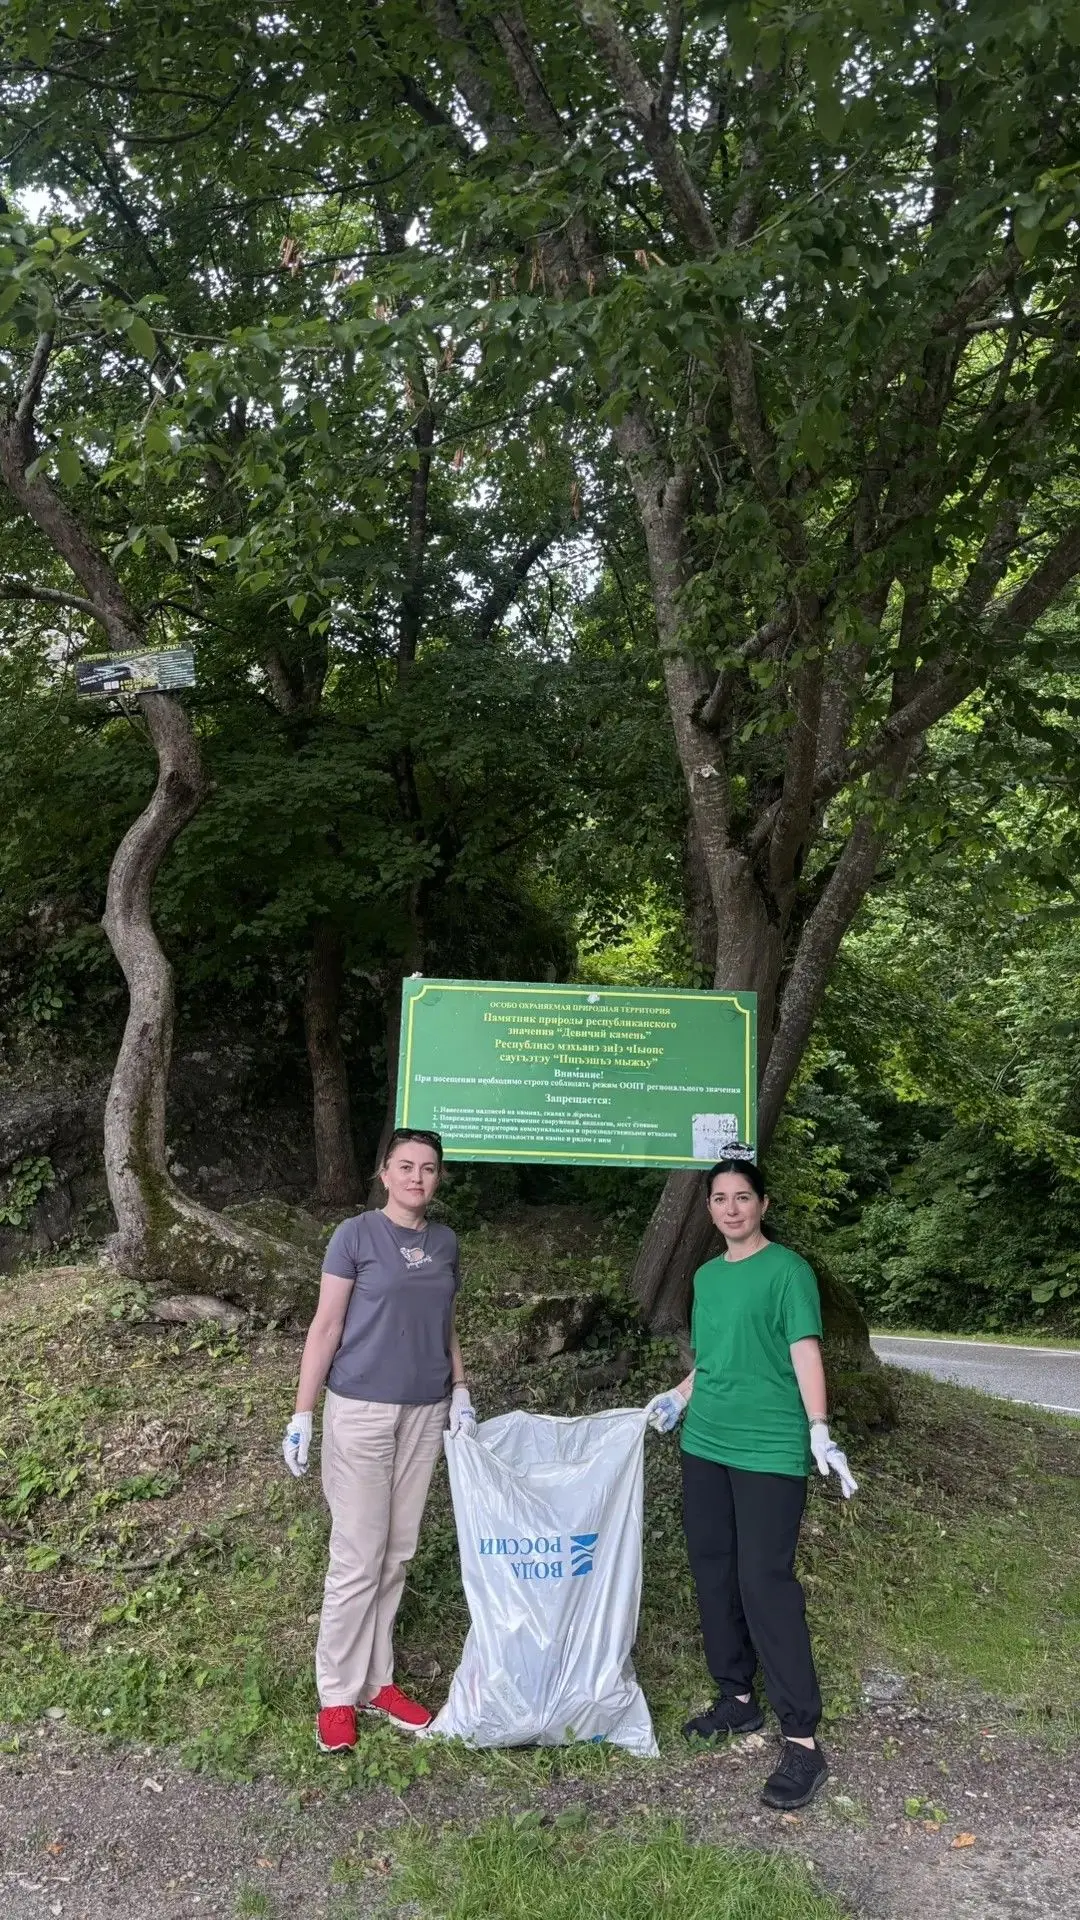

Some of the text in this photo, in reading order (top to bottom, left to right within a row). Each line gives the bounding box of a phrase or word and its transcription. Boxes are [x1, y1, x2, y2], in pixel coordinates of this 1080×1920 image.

[518, 1003, 571, 1011] ОХРАНЯЕМАЯ
[572, 1004, 619, 1013] ПРИРОДНАЯ
[621, 1006, 671, 1015] ТЕРРИТОРИЯ
[484, 1012, 677, 1029] Памятник природы республиканского
[508, 1027, 652, 1040] значения “Девичий камень”
[495, 1038, 555, 1051] Республикэ
[500, 1054, 550, 1064] саугъэтэу
[554, 1069, 604, 1079] Внимание!
[415, 1074, 431, 1083] При
[433, 1075, 475, 1083] посещении
[478, 1076, 522, 1085] необходимо
[524, 1079, 548, 1087] строго
[550, 1078, 590, 1088] соблюдать
[620, 1082, 644, 1090] ООПТ
[646, 1084, 704, 1092] регионального
[706, 1086, 741, 1094] значения
[545, 1094, 611, 1105] Запрещается:
[480, 1536, 562, 1555] РОССИИ
[511, 1560, 563, 1580] ВОДА
